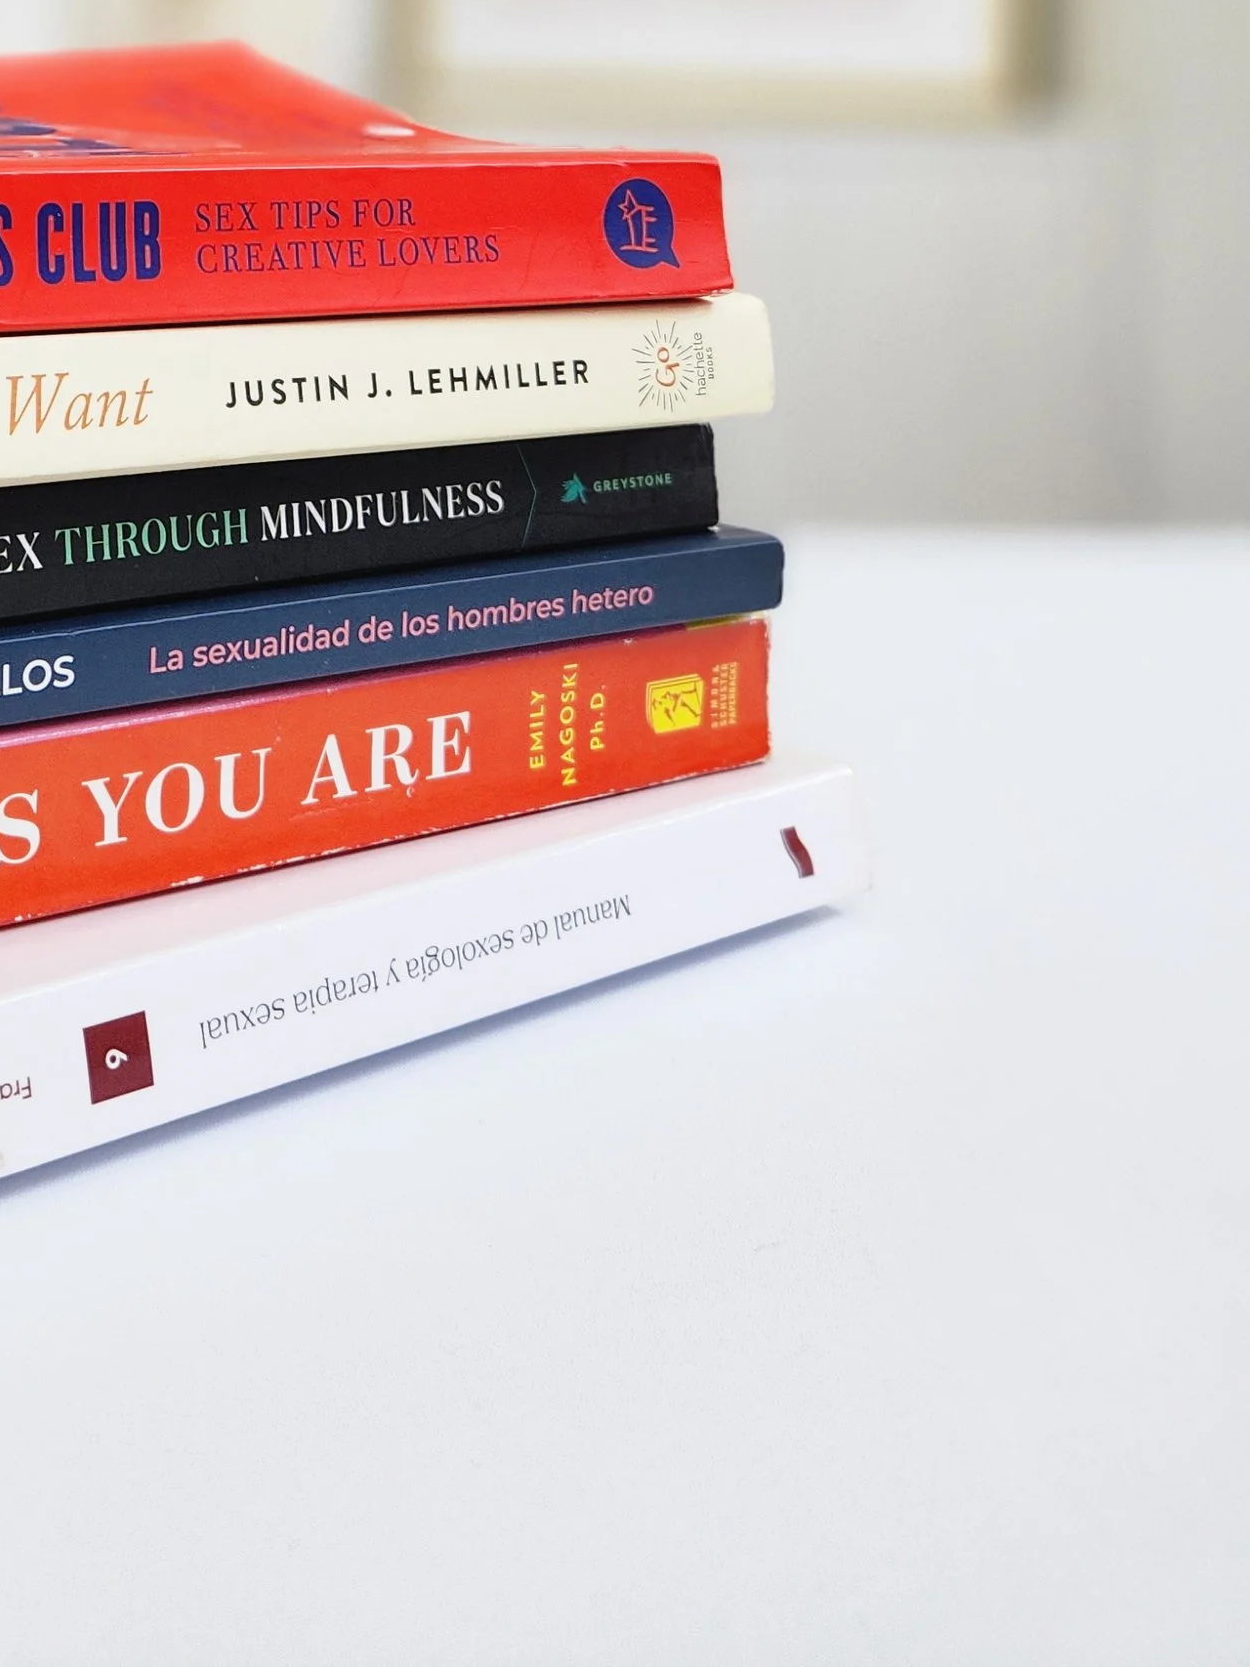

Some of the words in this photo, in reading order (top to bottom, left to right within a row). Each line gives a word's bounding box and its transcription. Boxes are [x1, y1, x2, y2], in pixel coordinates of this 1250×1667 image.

[196, 203, 258, 232] SEX
[270, 200, 340, 230] TIPS
[354, 199, 415, 227] FOR
[38, 202, 160, 284] CLUB
[196, 240, 366, 273] CREATIVE
[378, 235, 499, 266] LOVERS
[226, 375, 348, 408] JUSTIN
[368, 373, 391, 398] J.
[409, 360, 588, 395] LEHMILLER
[694, 331, 707, 396] hachette
[707, 346, 715, 380] BOOKS
[6, 372, 153, 435] Want
[593, 473, 672, 492] GREYSTONE
[55, 509, 248, 565] THROUGH
[261, 481, 504, 541] MINDFULNESS
[151, 647, 183, 673] La
[193, 620, 349, 667] sexualidad
[358, 616, 393, 643] de
[401, 612, 439, 637] los
[447, 598, 564, 631] hombres
[571, 586, 653, 614] hetero
[530, 691, 545, 769] EMILY
[559, 664, 578, 785] NAGOSKI
[590, 685, 605, 750] Ph.D.
[82, 748, 271, 846] YOU
[301, 711, 470, 805] ARE
[520, 918, 549, 946] de
[554, 894, 632, 940] Manual
[385, 958, 401, 987] y
[406, 928, 515, 983] sexología
[294, 970, 379, 1015] terapia
[198, 996, 285, 1049] sexual
